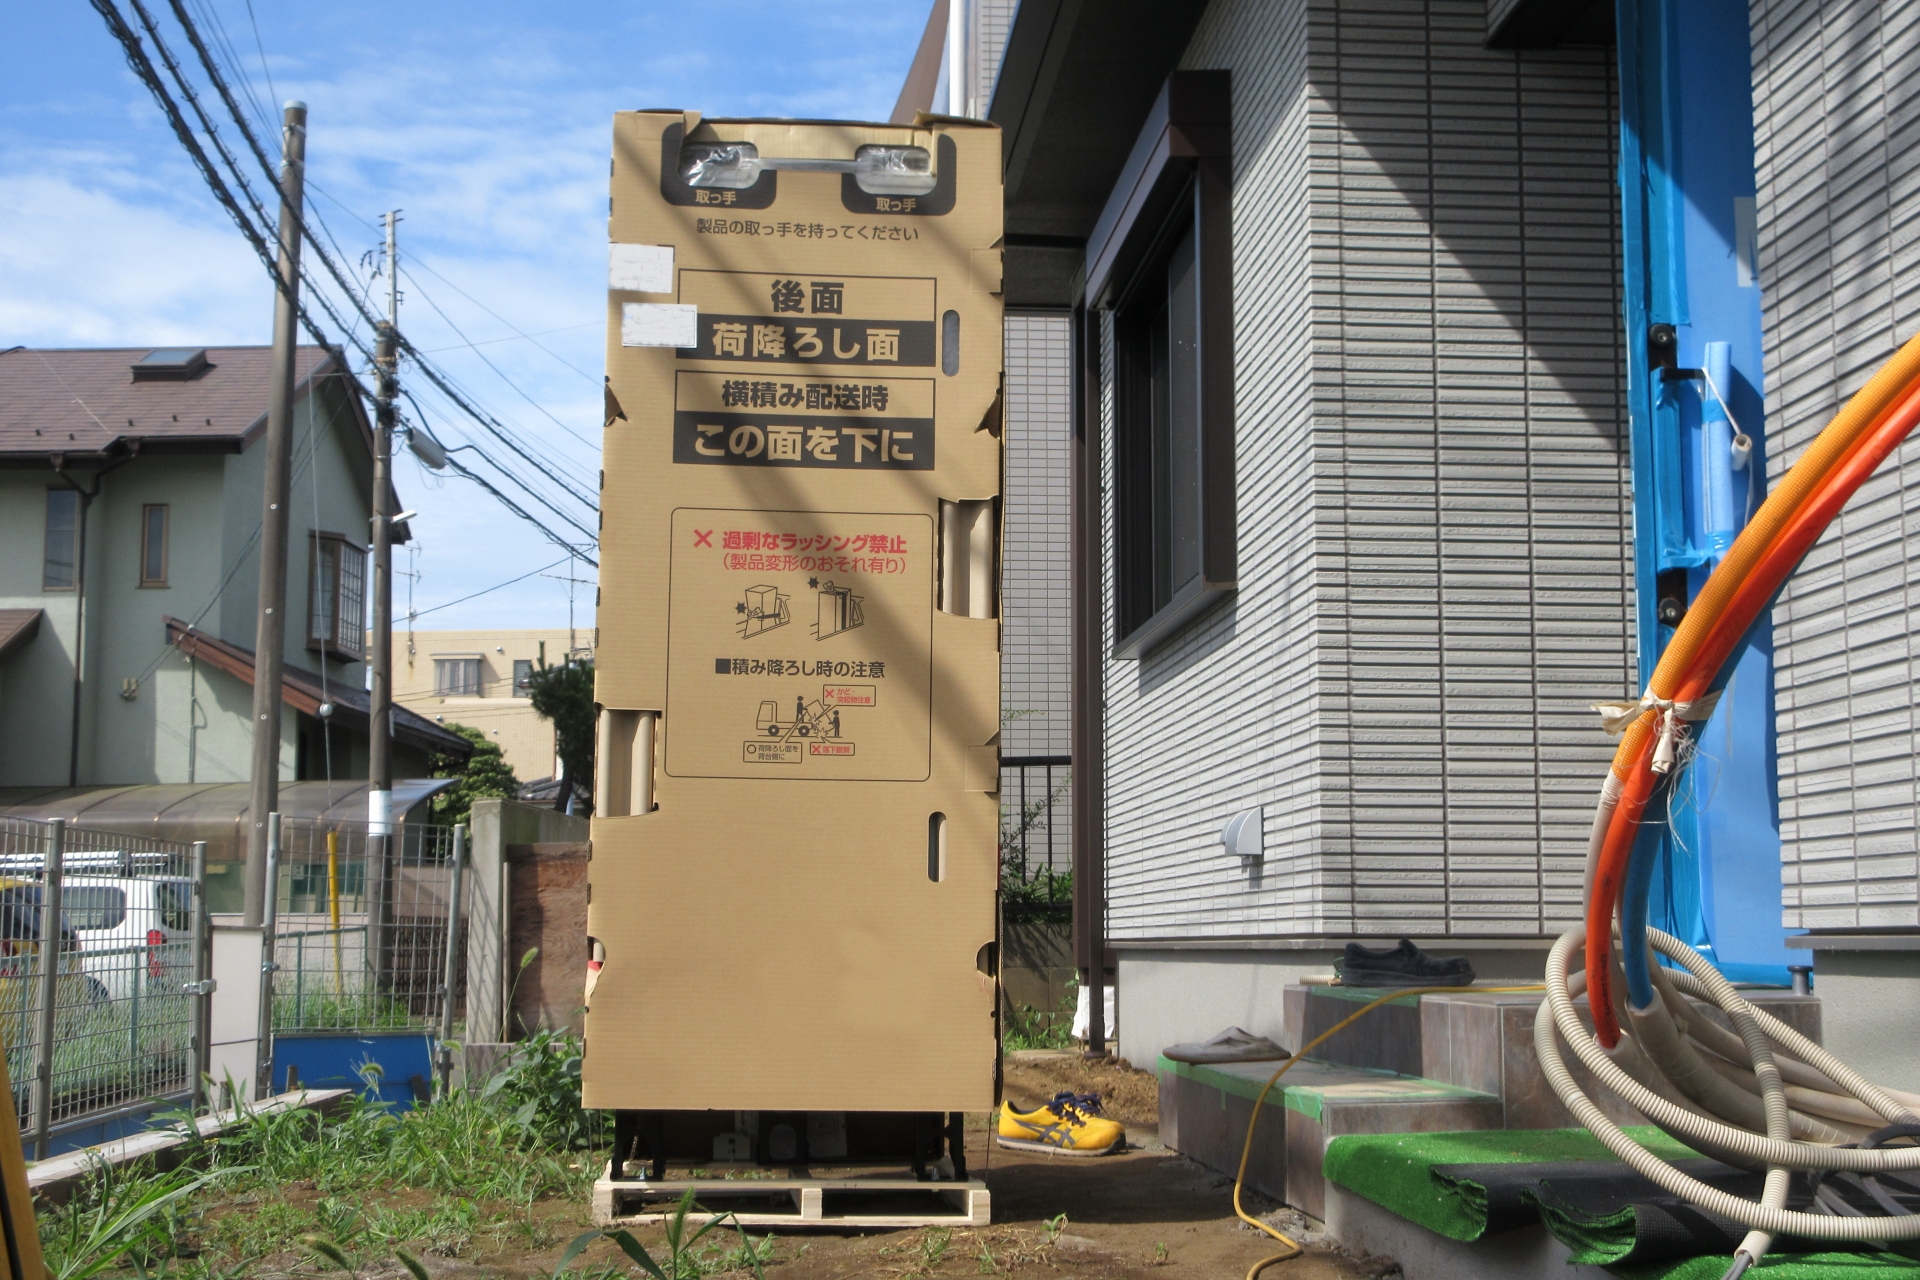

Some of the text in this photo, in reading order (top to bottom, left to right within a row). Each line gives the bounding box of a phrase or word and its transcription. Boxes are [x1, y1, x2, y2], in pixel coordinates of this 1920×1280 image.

[695, 189, 736, 205] 取っ手
[876, 197, 917, 212] 取っ手
[696, 218, 919, 241] 製品の取っ手を持ってください
[771, 279, 844, 314] 後面
[712, 322, 900, 362] 荷降ろし面
[721, 379, 888, 411] 横積み配送時
[694, 424, 914, 463] この面を下に
[722, 530, 908, 554] 過剰なラッシング禁止
[758, 744, 799, 753] 荷降ろし面を
